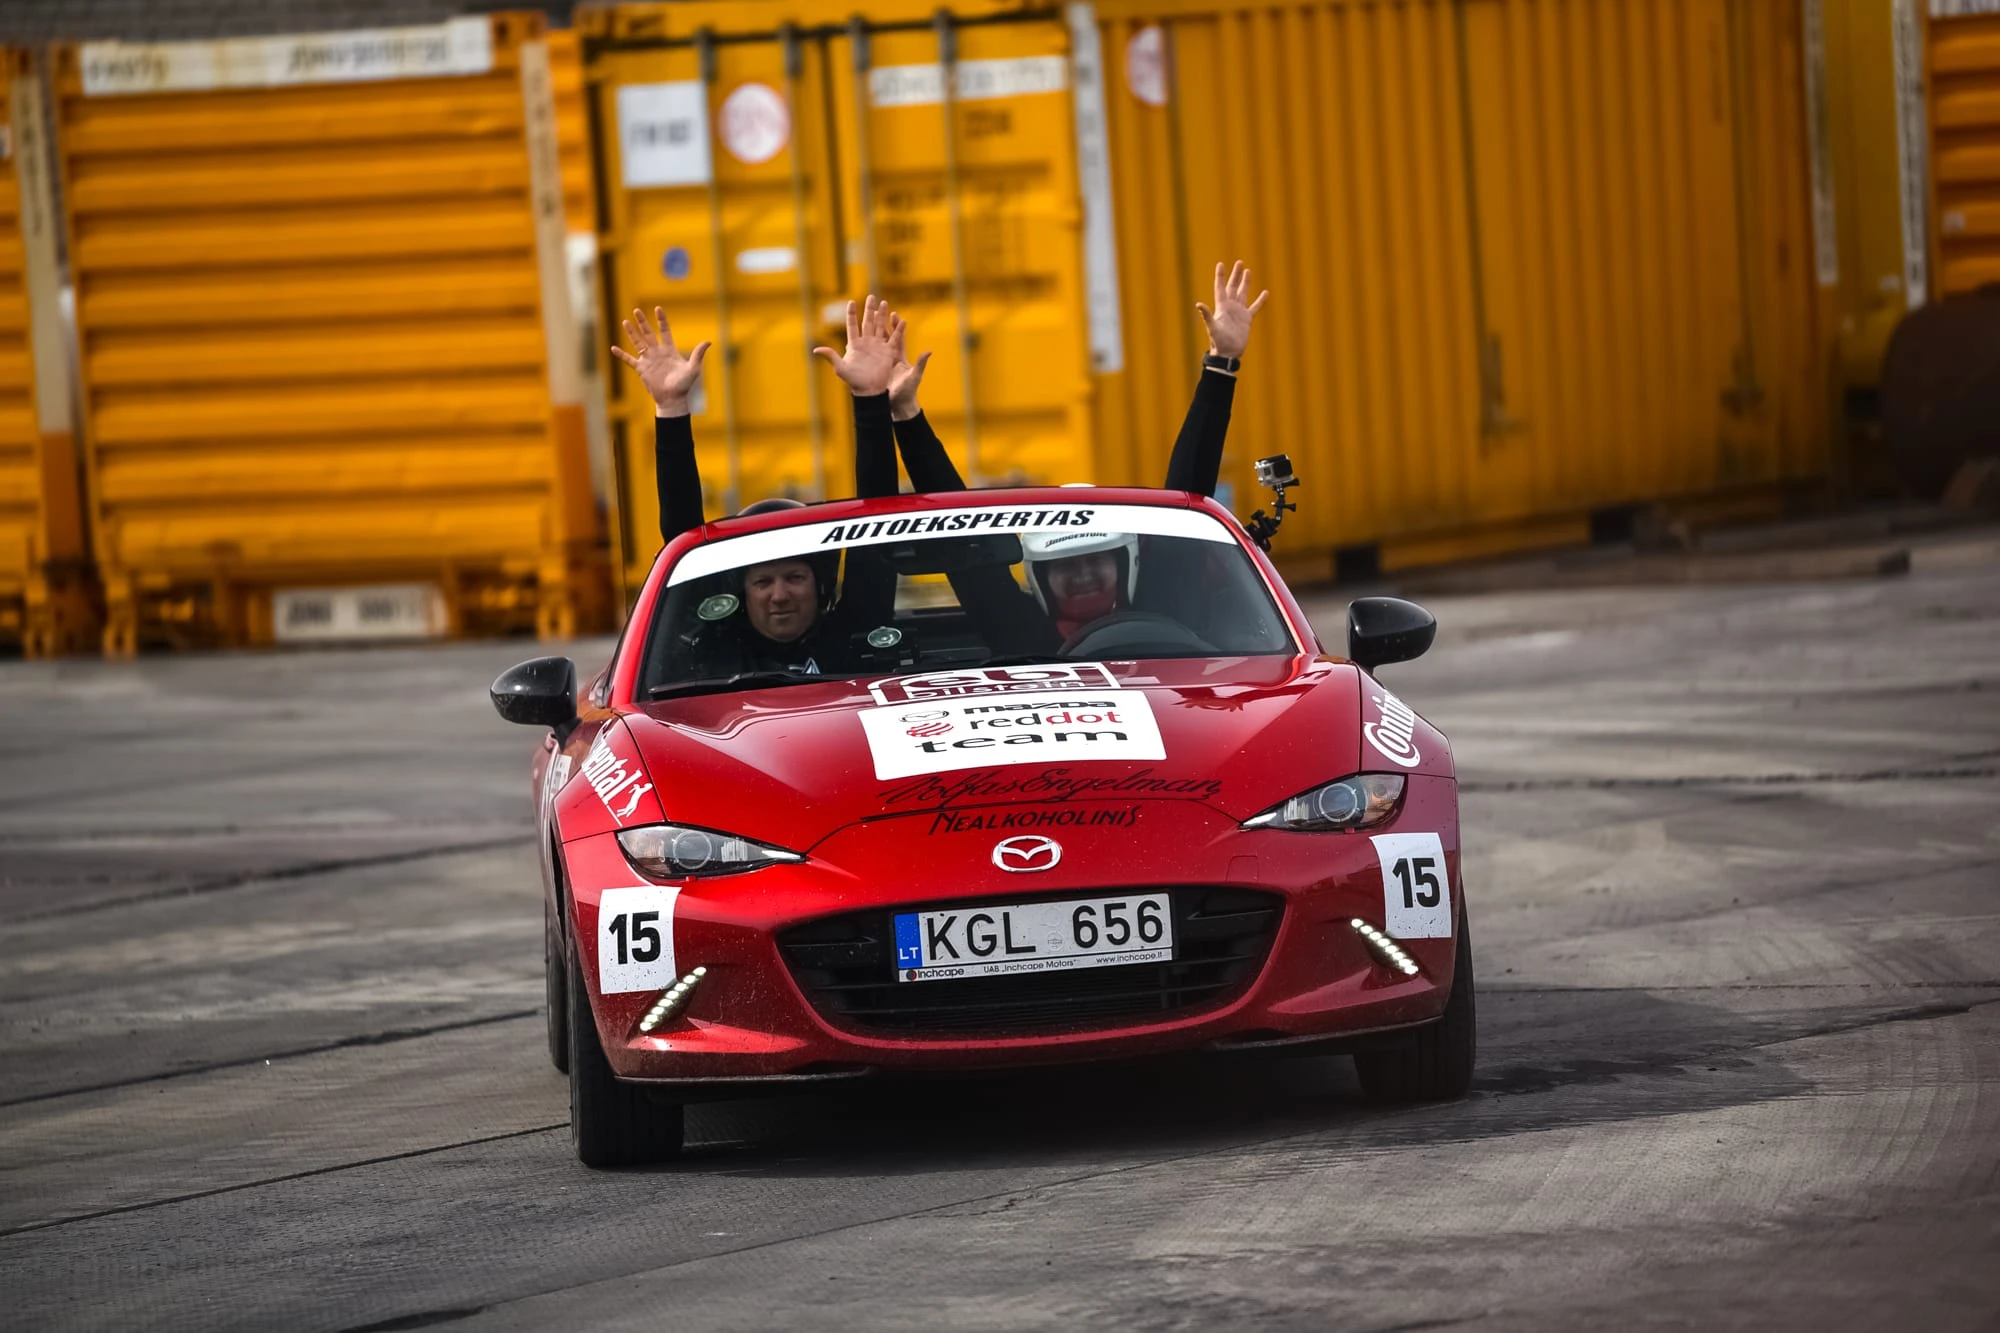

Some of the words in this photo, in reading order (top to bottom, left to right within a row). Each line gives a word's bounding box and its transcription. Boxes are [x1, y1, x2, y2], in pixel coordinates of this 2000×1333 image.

[820, 509, 1095, 544] AUTOEKSPERTAS
[877, 666, 1115, 704] febi
[908, 680, 1086, 700] bilstein
[914, 731, 1129, 753] team
[1019, 768, 1222, 801] Engelman
[928, 804, 1143, 836] NEALKOHOLINIS
[1392, 857, 1441, 908] 15
[608, 910, 661, 966] 15
[926, 911, 1037, 961] KGL
[1072, 900, 1164, 949] 656
[899, 946, 919, 960] LT
[983, 964, 1000, 974] UAB
[1096, 950, 1163, 965] www.inchcape.lt
[917, 966, 965, 980] Inchcape
